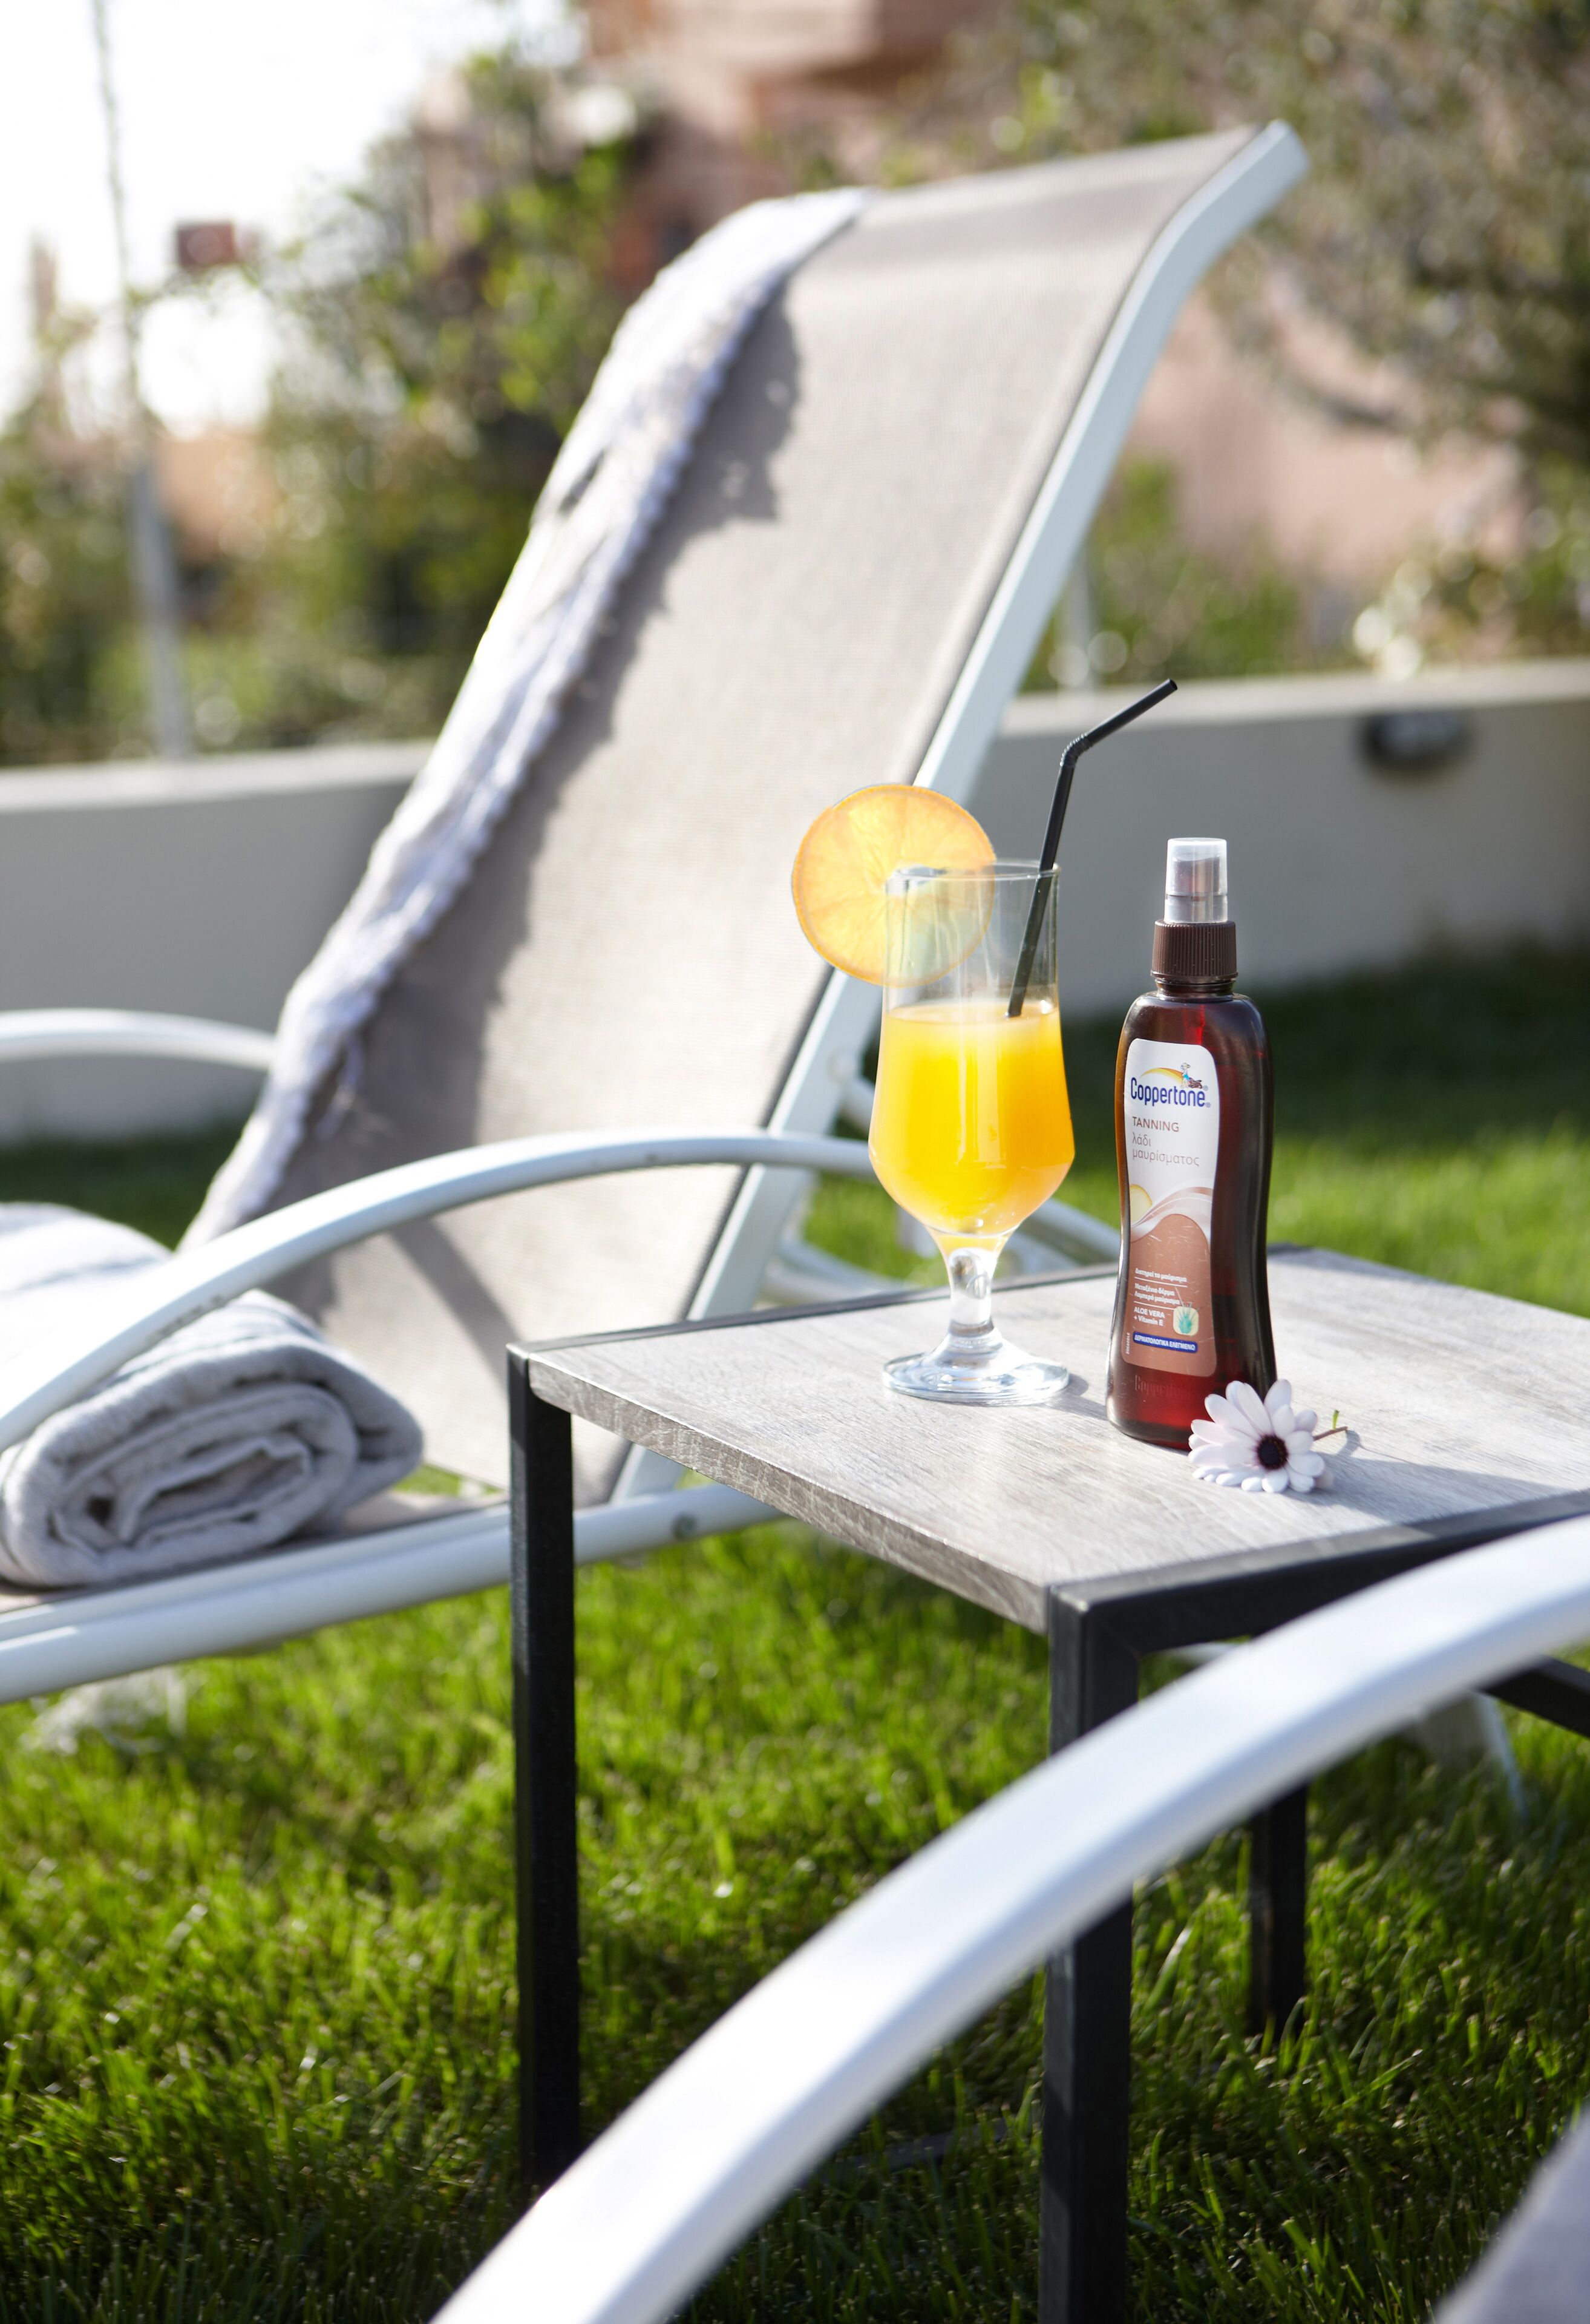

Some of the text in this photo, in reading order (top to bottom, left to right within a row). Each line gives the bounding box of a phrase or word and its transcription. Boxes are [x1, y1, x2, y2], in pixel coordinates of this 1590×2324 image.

[1131, 1077, 1205, 1108] Coppertone
[1133, 1117, 1179, 1132] TANNING
[1133, 1132, 1151, 1147] λάδι
[1133, 1149, 1199, 1167] μαυρίσματος
[1134, 1307, 1165, 1318] ALOE VERA
[1138, 1316, 1158, 1325] Vitamin
